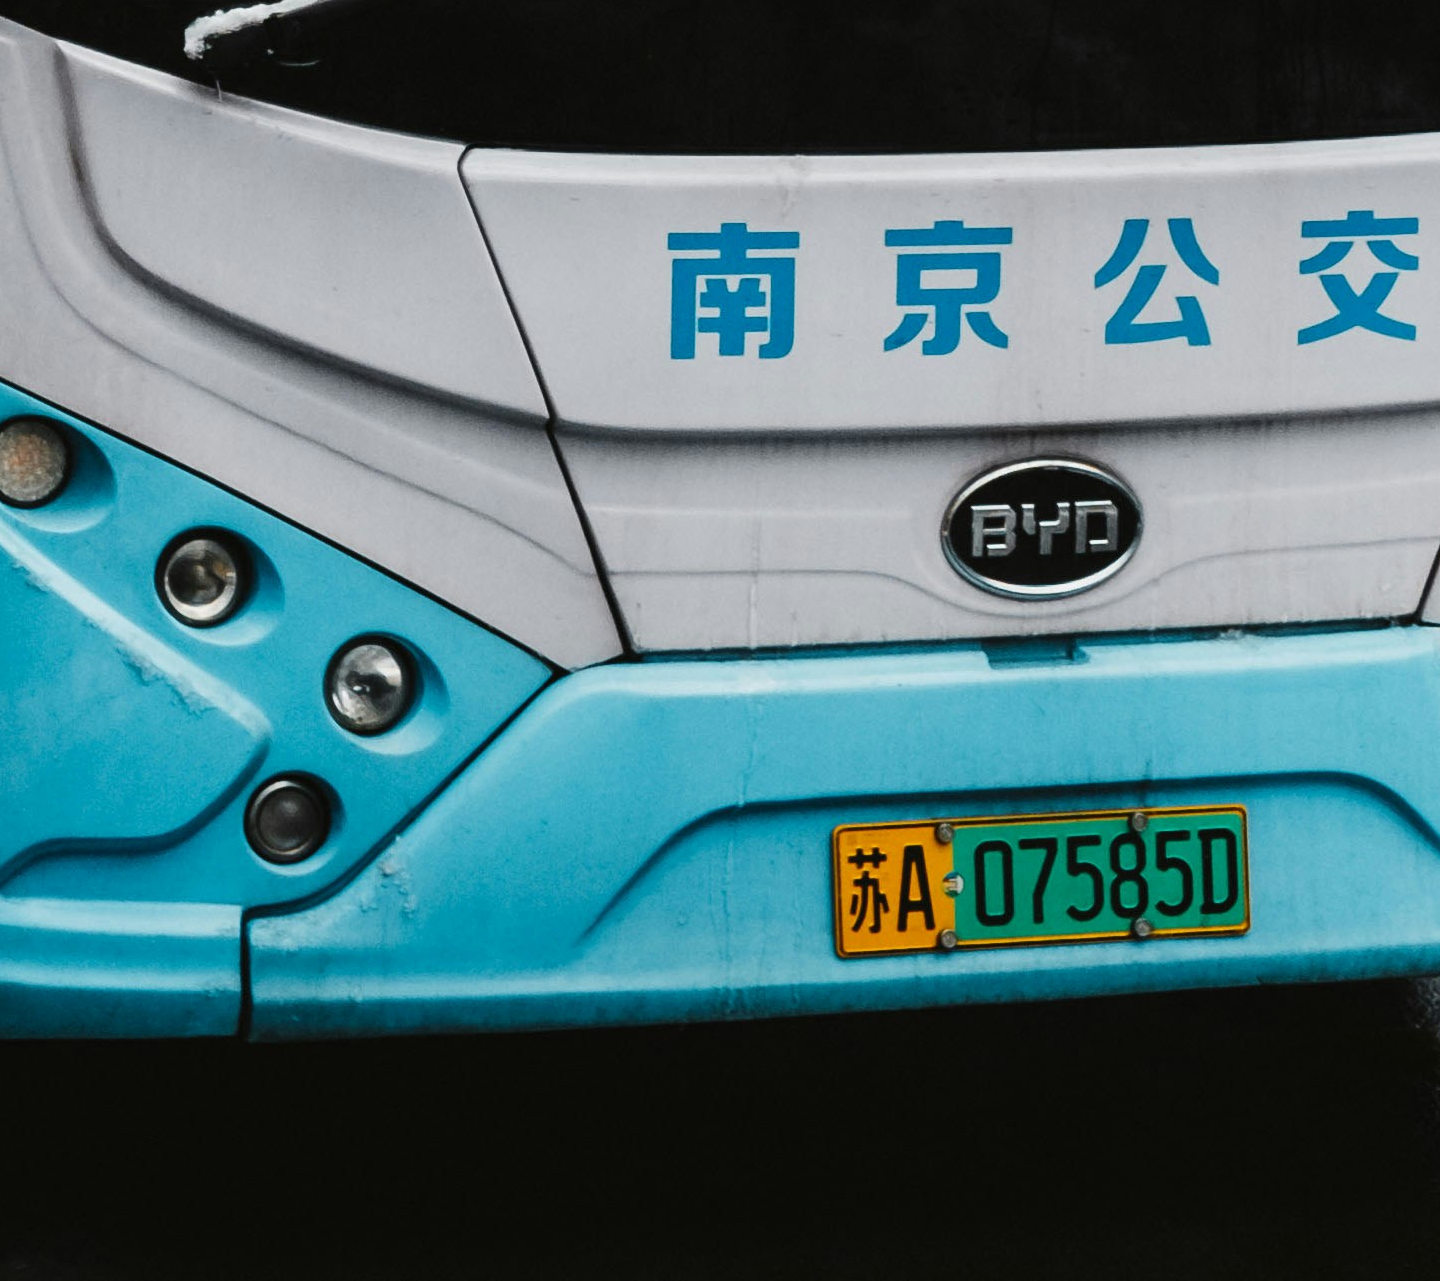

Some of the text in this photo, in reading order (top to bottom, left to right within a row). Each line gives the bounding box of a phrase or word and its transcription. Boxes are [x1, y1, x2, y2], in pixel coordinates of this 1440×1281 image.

[667, 210, 1420, 359] 南京公交
[971, 500, 1118, 558] BYD
